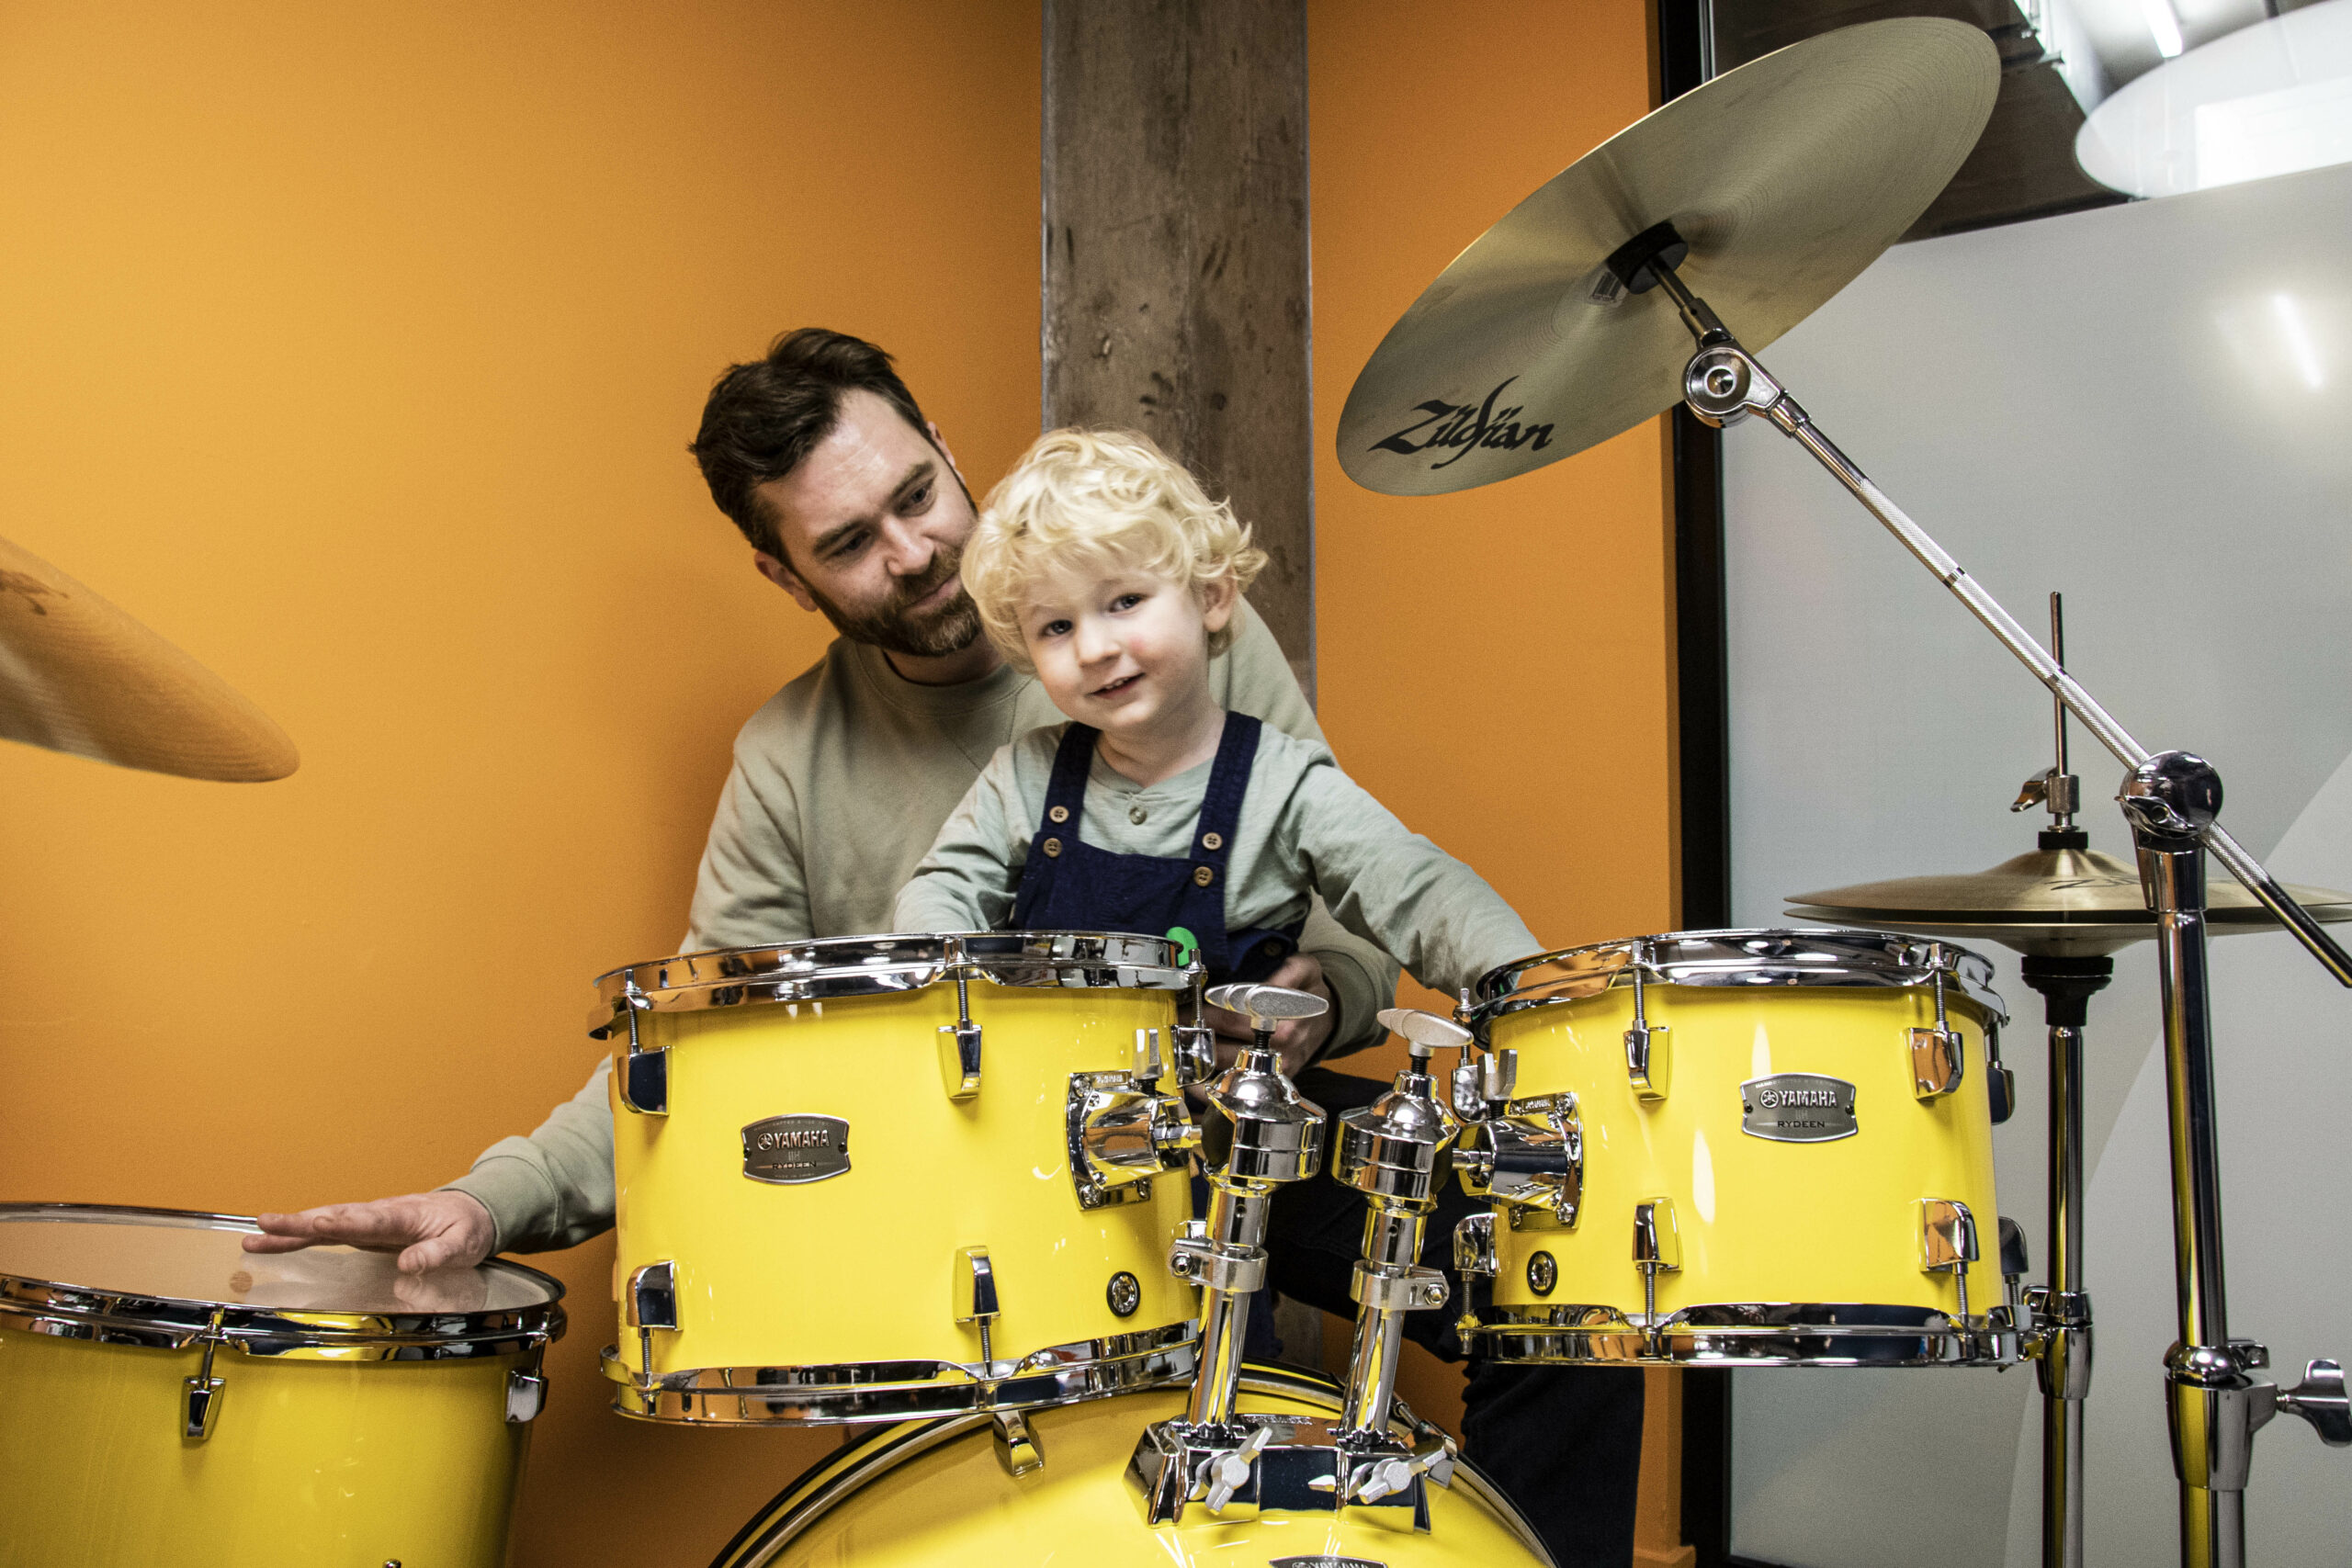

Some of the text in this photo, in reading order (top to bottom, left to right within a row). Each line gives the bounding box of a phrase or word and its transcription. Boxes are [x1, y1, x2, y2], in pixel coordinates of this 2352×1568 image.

[1366, 375, 1555, 469] Zildjian
[1779, 1089, 1838, 1108] YAMAHA
[1777, 1121, 1826, 1129] RYDEEN
[774, 1129, 831, 1149] YAMAHA
[772, 1161, 817, 1170] RYDEEN
